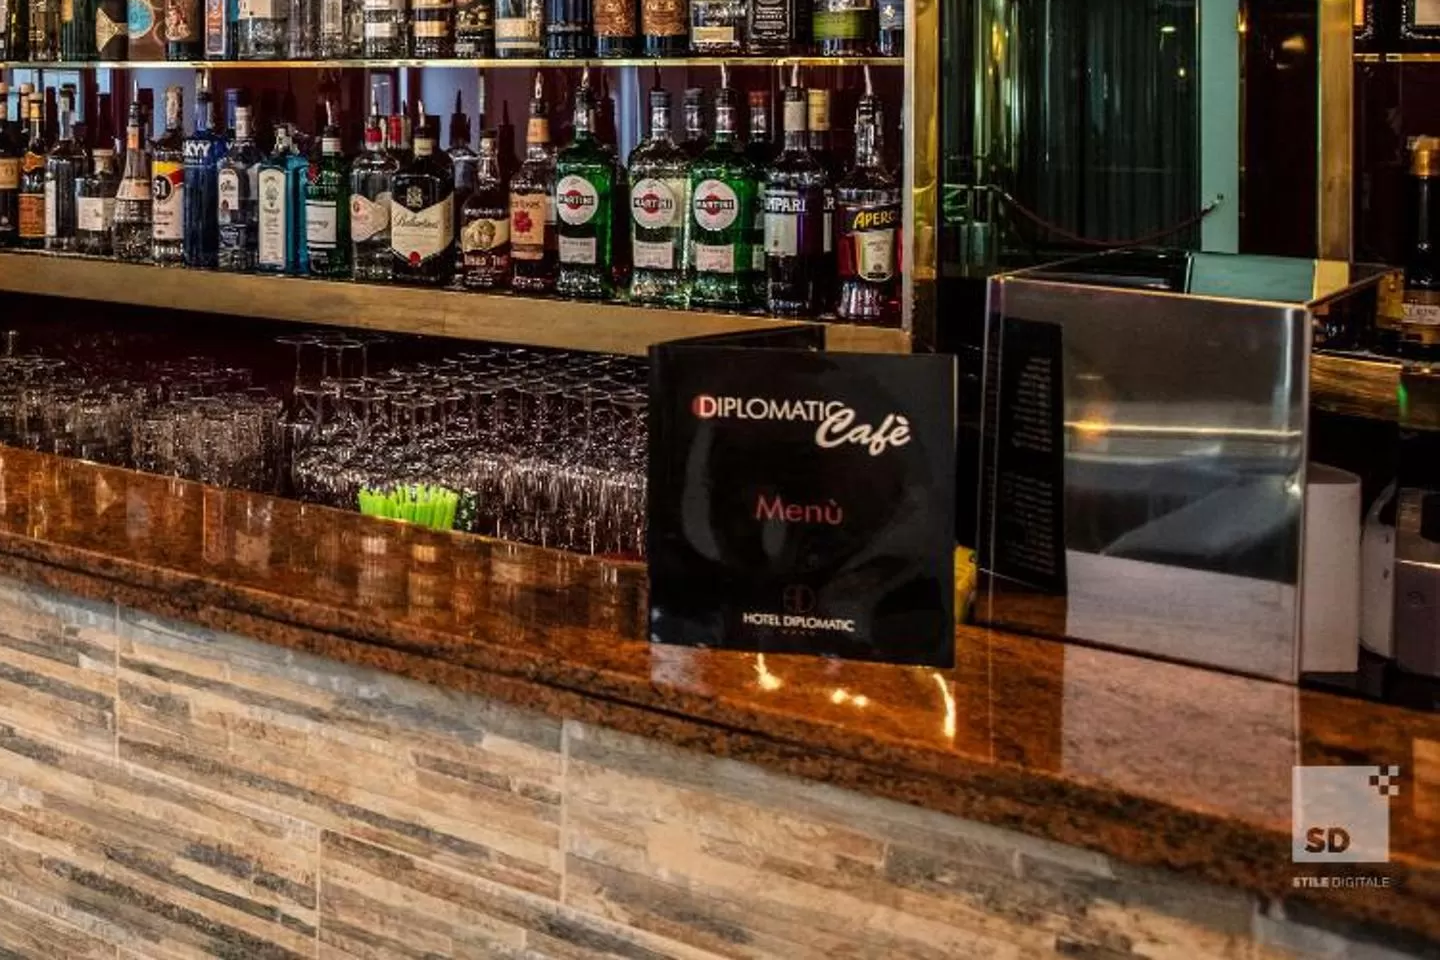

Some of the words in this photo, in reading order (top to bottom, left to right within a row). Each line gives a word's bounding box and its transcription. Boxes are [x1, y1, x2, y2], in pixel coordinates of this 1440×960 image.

[699, 396, 845, 422] DIPLOMATIC
[756, 495, 843, 525] Menù
[743, 612, 781, 627] HOTEL
[783, 615, 855, 632] DIPLOMATIC
